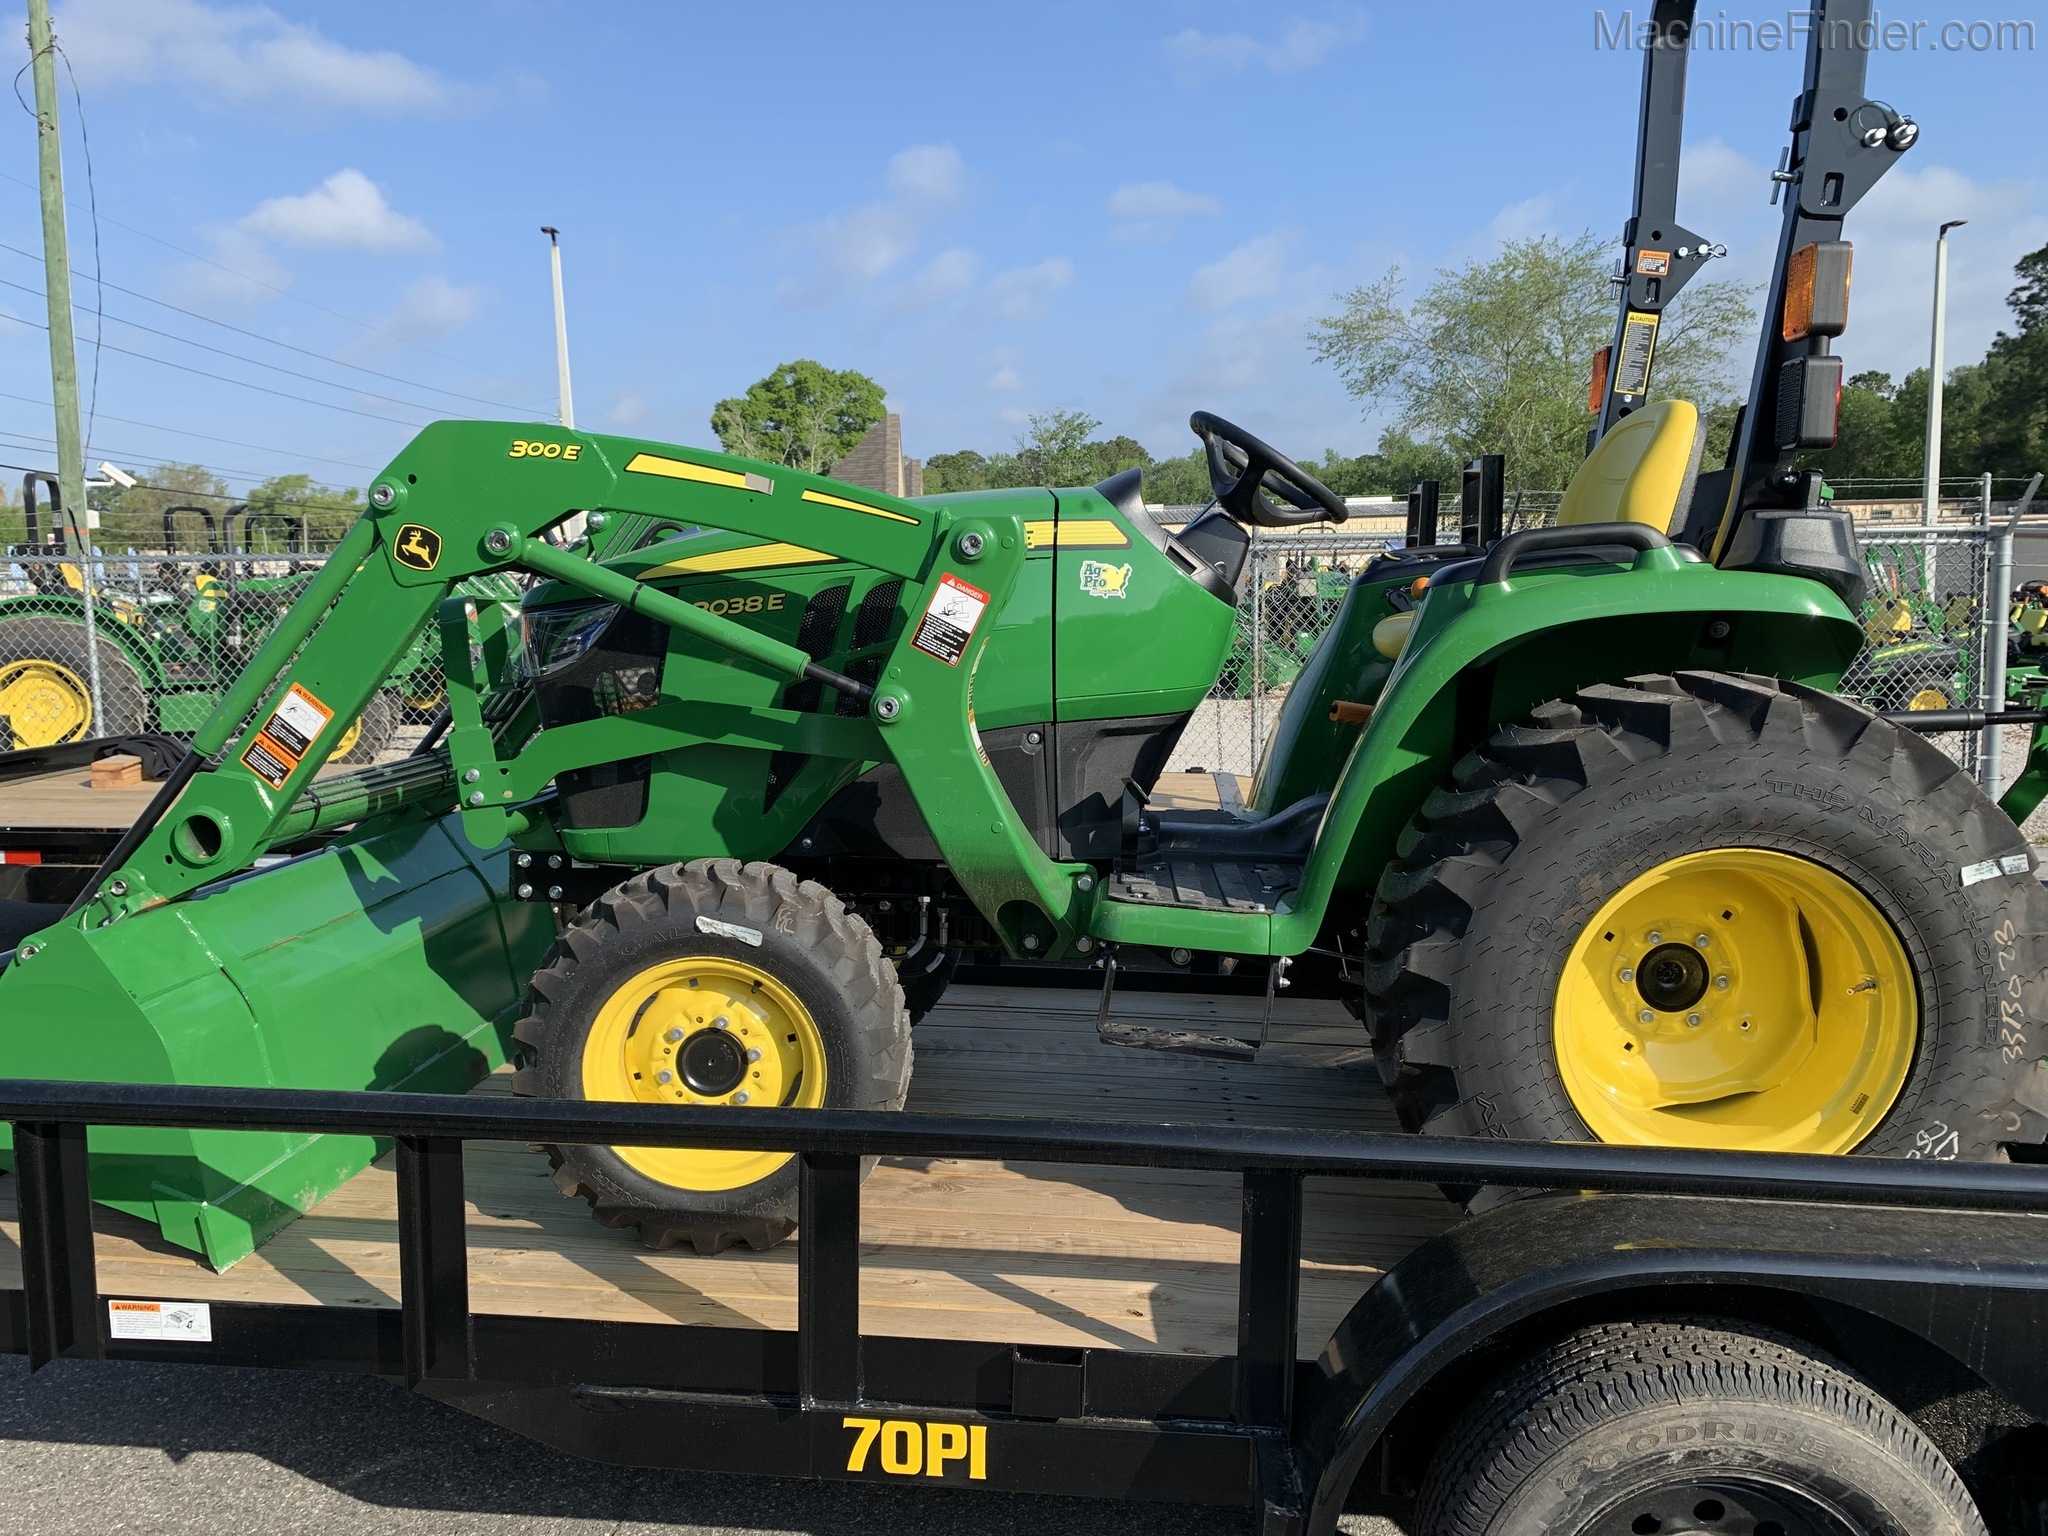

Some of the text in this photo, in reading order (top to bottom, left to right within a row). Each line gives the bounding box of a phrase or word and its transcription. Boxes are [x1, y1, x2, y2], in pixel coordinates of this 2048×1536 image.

[1634, 315, 1657, 324] CAUTION
[1083, 563, 1107, 577] Ag-
[956, 582, 984, 601] DANGER
[1083, 576, 1107, 588] Pro
[302, 690, 328, 715] WARNING
[266, 742, 292, 766] WARNING
[1765, 778, 1847, 808] THE
[1857, 804, 2000, 1046] MARATHONER
[843, 1417, 988, 1480] 70PI
